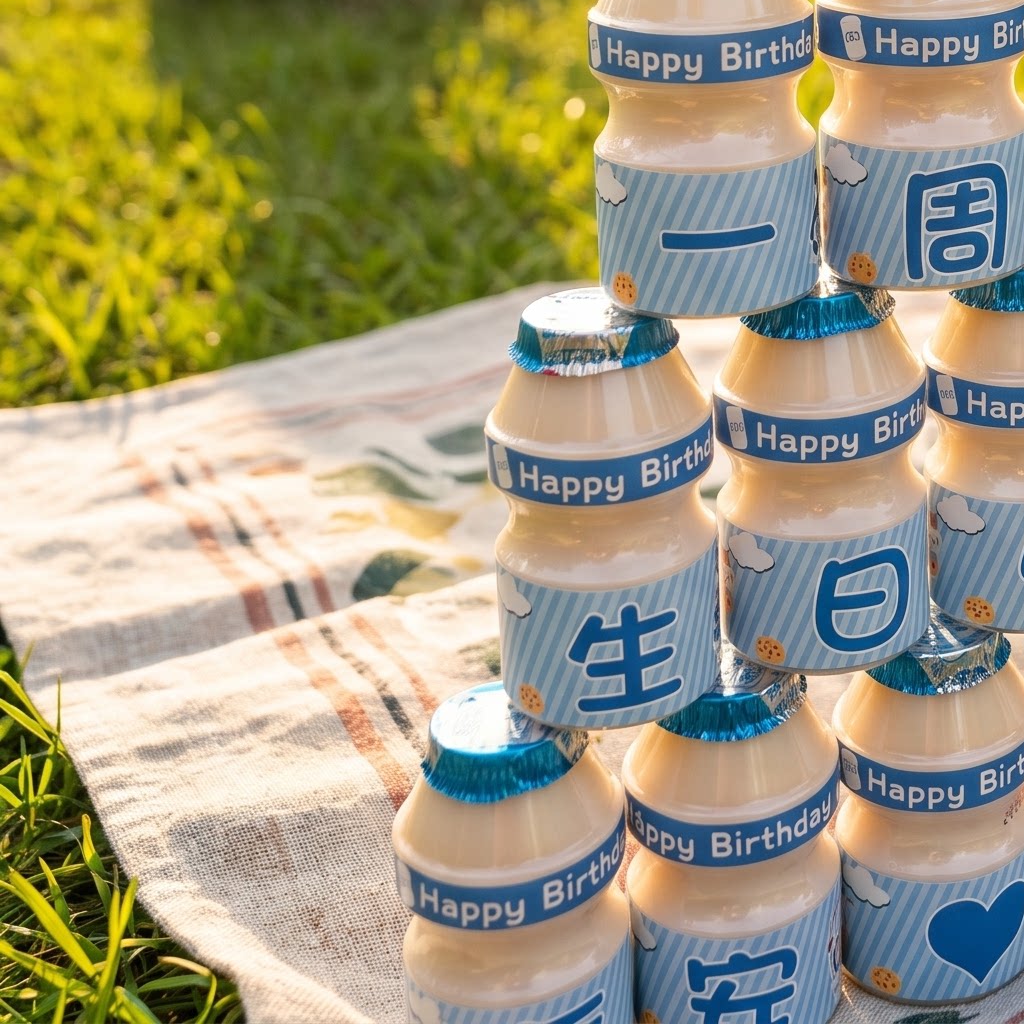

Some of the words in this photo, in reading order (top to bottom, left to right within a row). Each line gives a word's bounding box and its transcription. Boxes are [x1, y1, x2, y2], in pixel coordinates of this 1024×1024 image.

[607, 37, 703, 81] Happy
[875, 27, 980, 63] Happy
[661, 221, 776, 252] 一
[907, 160, 1009, 281] 周
[757, 421, 859, 461] Happy
[519, 461, 625, 504] Happy
[813, 545, 910, 654] 日
[566, 602, 684, 714] 生
[867, 767, 965, 810] Happy
[711, 792, 832, 859] Birthday
[420, 883, 526, 928] Happy
